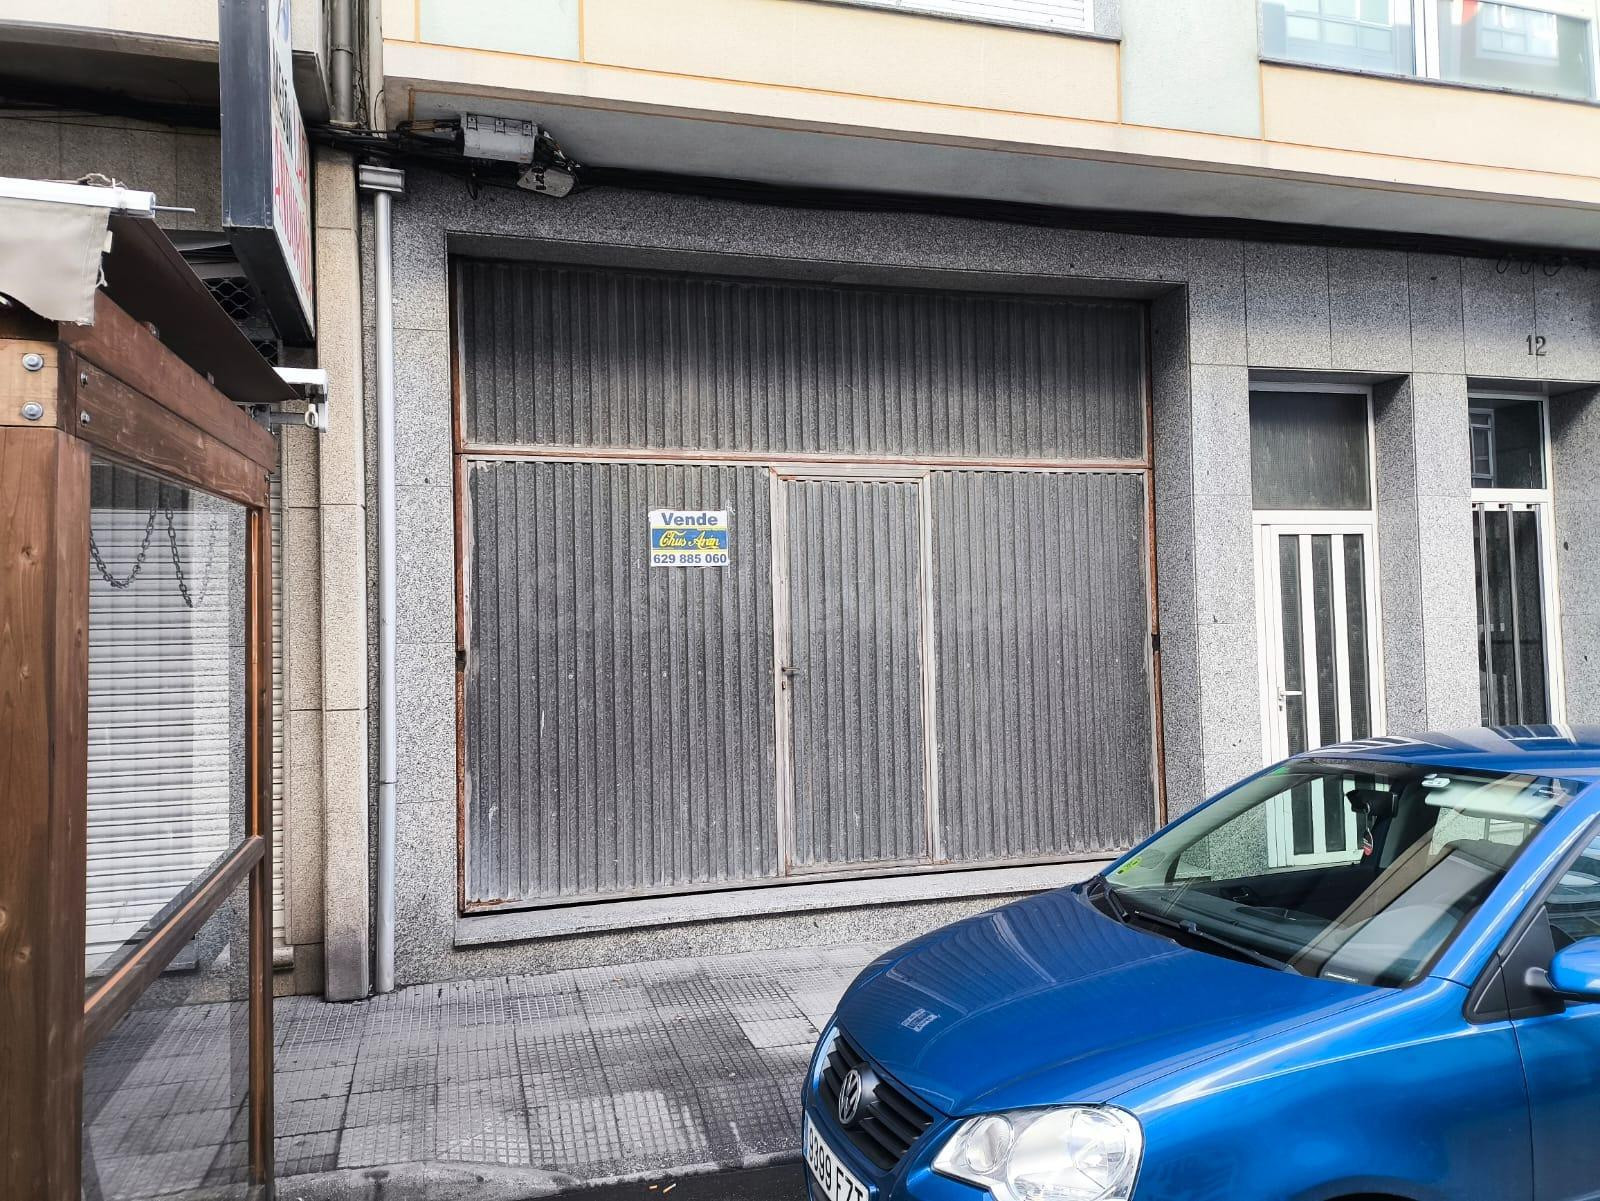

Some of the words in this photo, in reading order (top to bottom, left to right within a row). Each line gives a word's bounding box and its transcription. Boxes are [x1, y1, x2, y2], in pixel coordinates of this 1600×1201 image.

[1526, 335, 1546, 356] 12
[661, 512, 718, 525] Vende
[653, 554, 676, 563] 629
[680, 554, 701, 563] 885
[705, 554, 727, 563] 060
